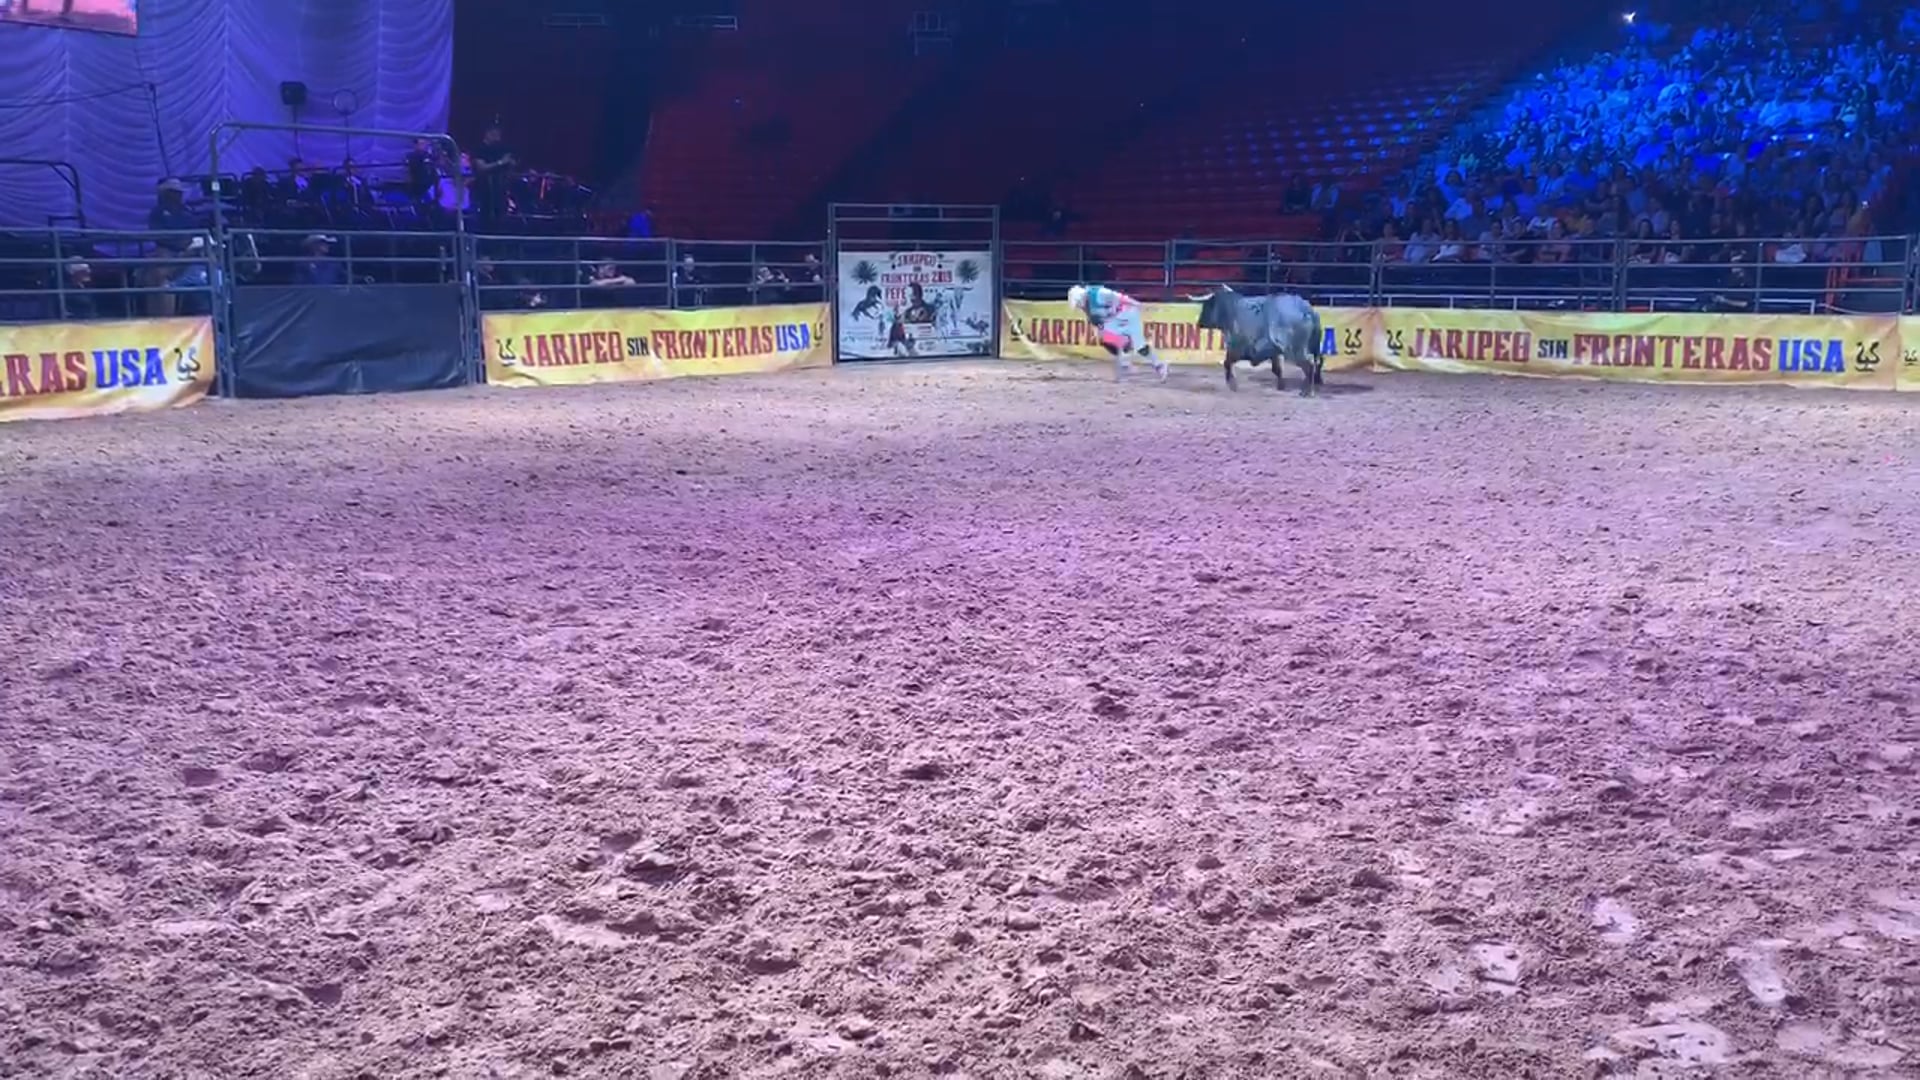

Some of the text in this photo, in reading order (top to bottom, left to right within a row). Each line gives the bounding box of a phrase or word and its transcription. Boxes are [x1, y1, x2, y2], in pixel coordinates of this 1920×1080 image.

[521, 323, 810, 367] JARIPEO SIN FRONTERAS USA
[1408, 328, 1846, 373] JARIPEO SIN FRONTERAS USA
[0, 348, 167, 397] RAS USA
